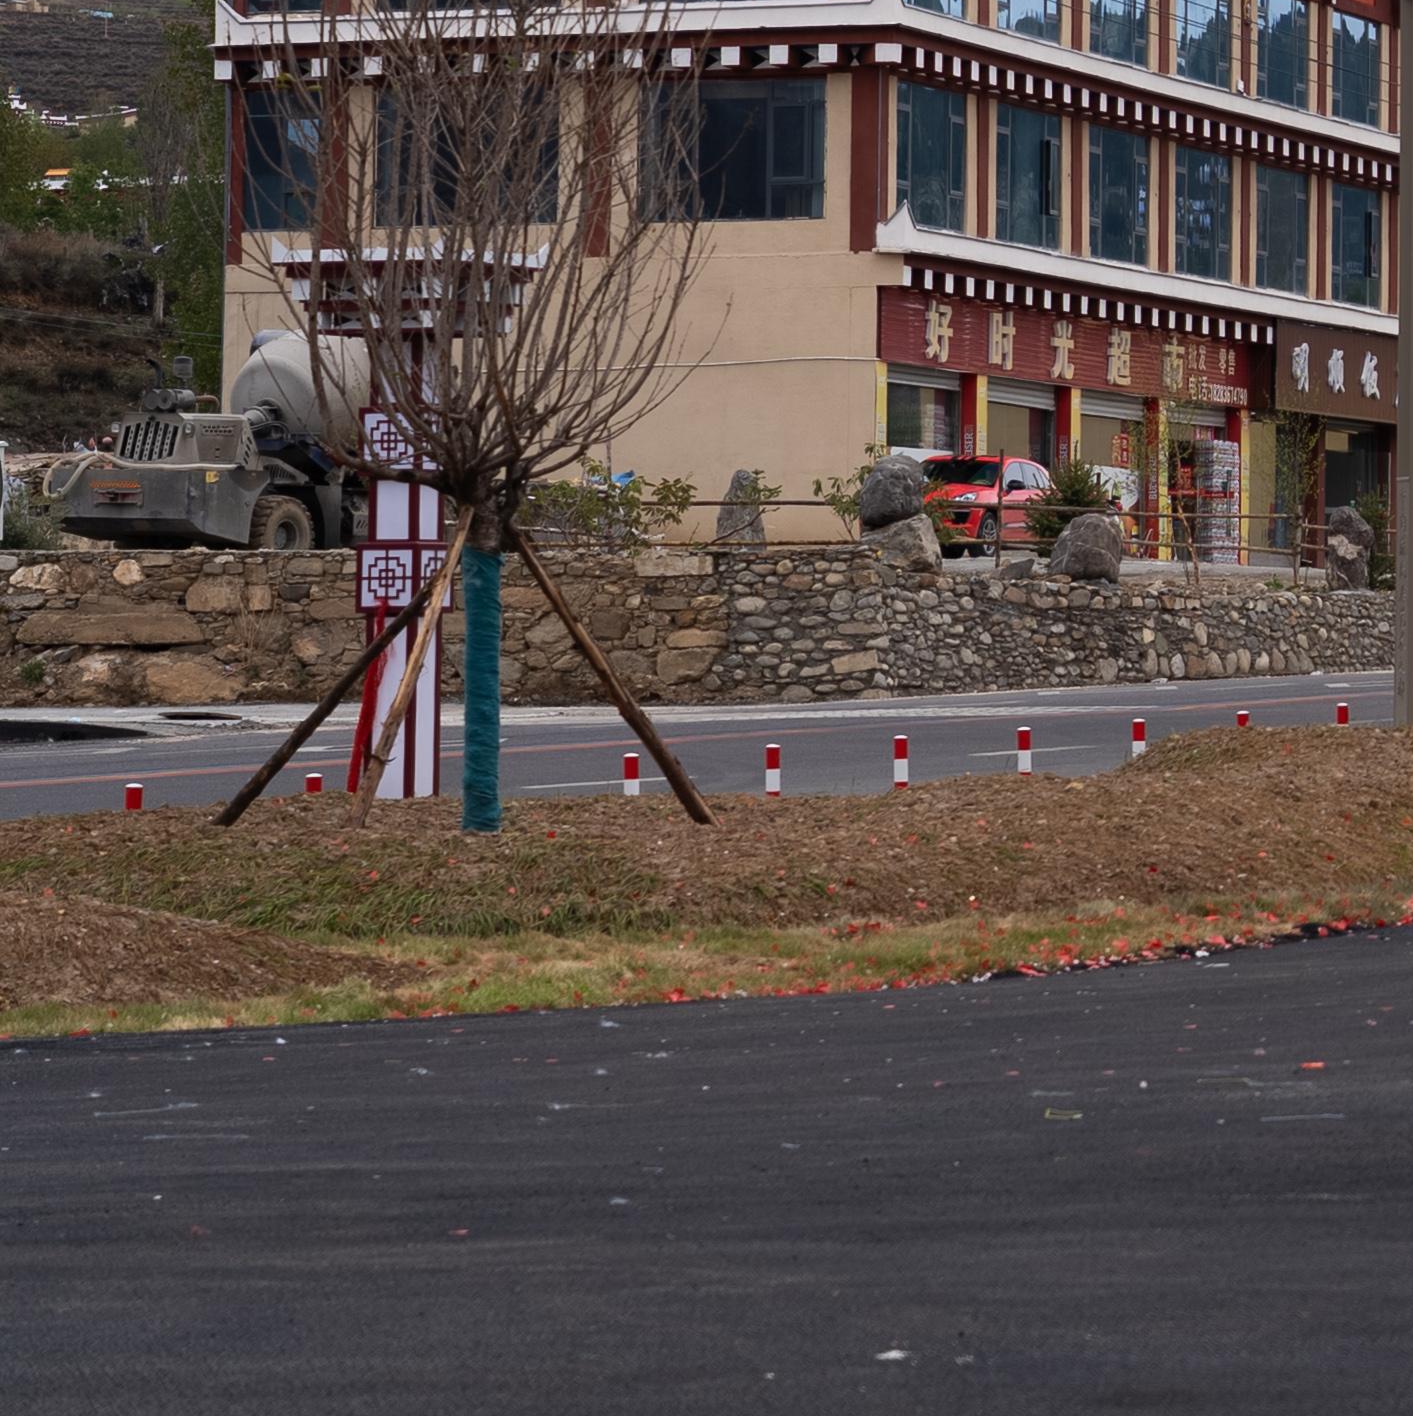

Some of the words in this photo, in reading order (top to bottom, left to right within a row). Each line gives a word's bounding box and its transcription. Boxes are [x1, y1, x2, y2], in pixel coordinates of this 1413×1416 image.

[925, 300, 1185, 391] 好时光超市
